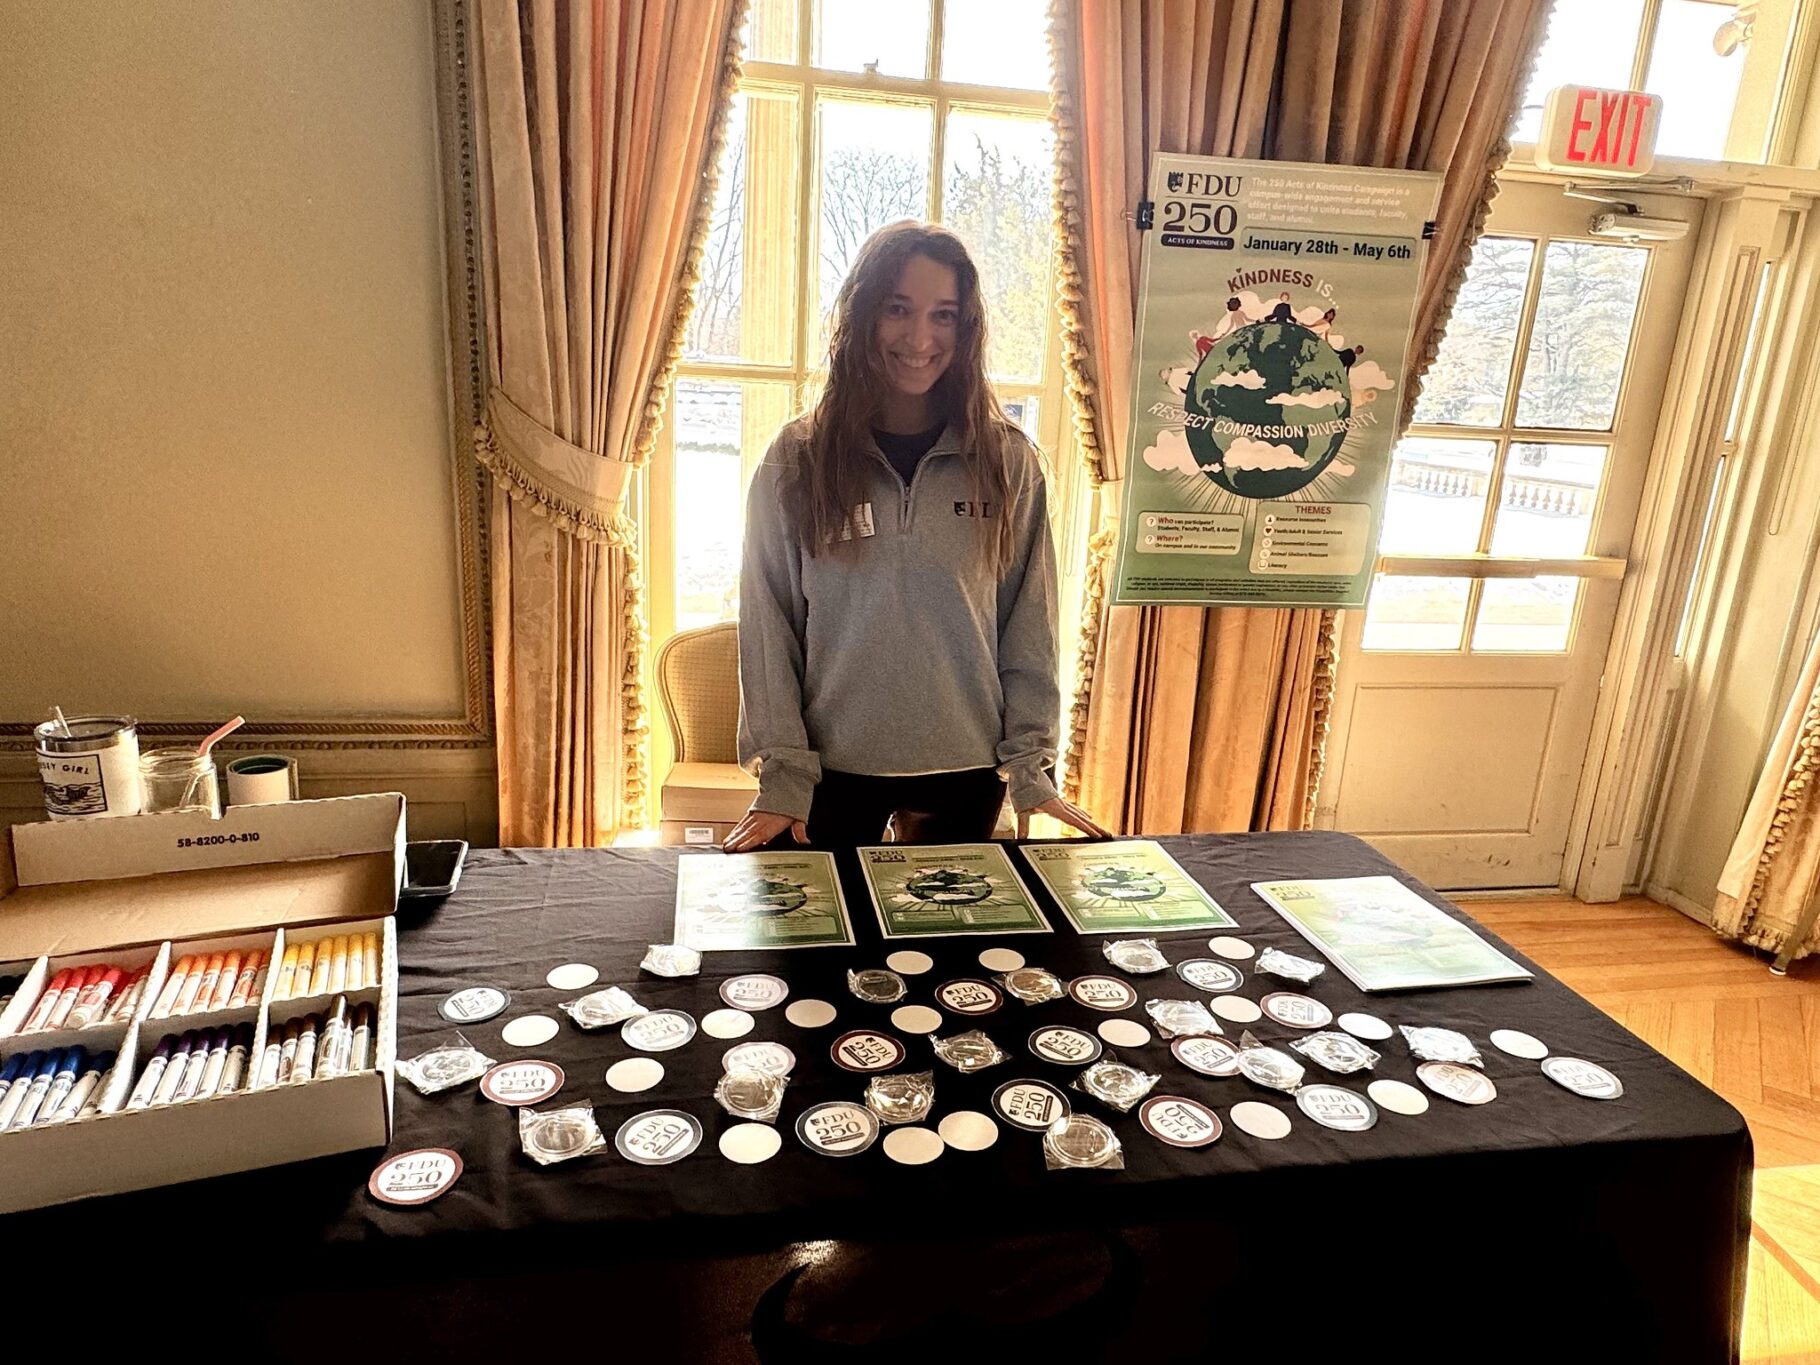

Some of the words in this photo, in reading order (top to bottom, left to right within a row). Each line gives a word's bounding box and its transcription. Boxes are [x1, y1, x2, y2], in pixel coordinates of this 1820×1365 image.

[1566, 88, 1652, 168] EXIT
[1185, 173, 1243, 197] FDU
[1163, 201, 1238, 235] 250
[1243, 235, 1302, 256] January
[1305, 239, 1339, 254] 28th
[1353, 242, 1384, 260] May
[1387, 244, 1412, 259] 6th
[1227, 267, 1314, 293] KINDNESS
[1147, 401, 1214, 430] RESPECT
[1213, 419, 1304, 439] COMPASSION
[1307, 411, 1379, 437] DIVERSITY
[1295, 505, 1332, 515] THEMES
[62, 764, 89, 775] GIRL
[952, 991, 988, 1005] 250
[848, 1041, 882, 1065] 250
[869, 1042, 895, 1059] FDU
[1043, 1037, 1082, 1056] 250
[1010, 1087, 1026, 1110] FDU
[1023, 1092, 1046, 1121] 250
[822, 1110, 855, 1125] FDU
[815, 1121, 862, 1141] 250
